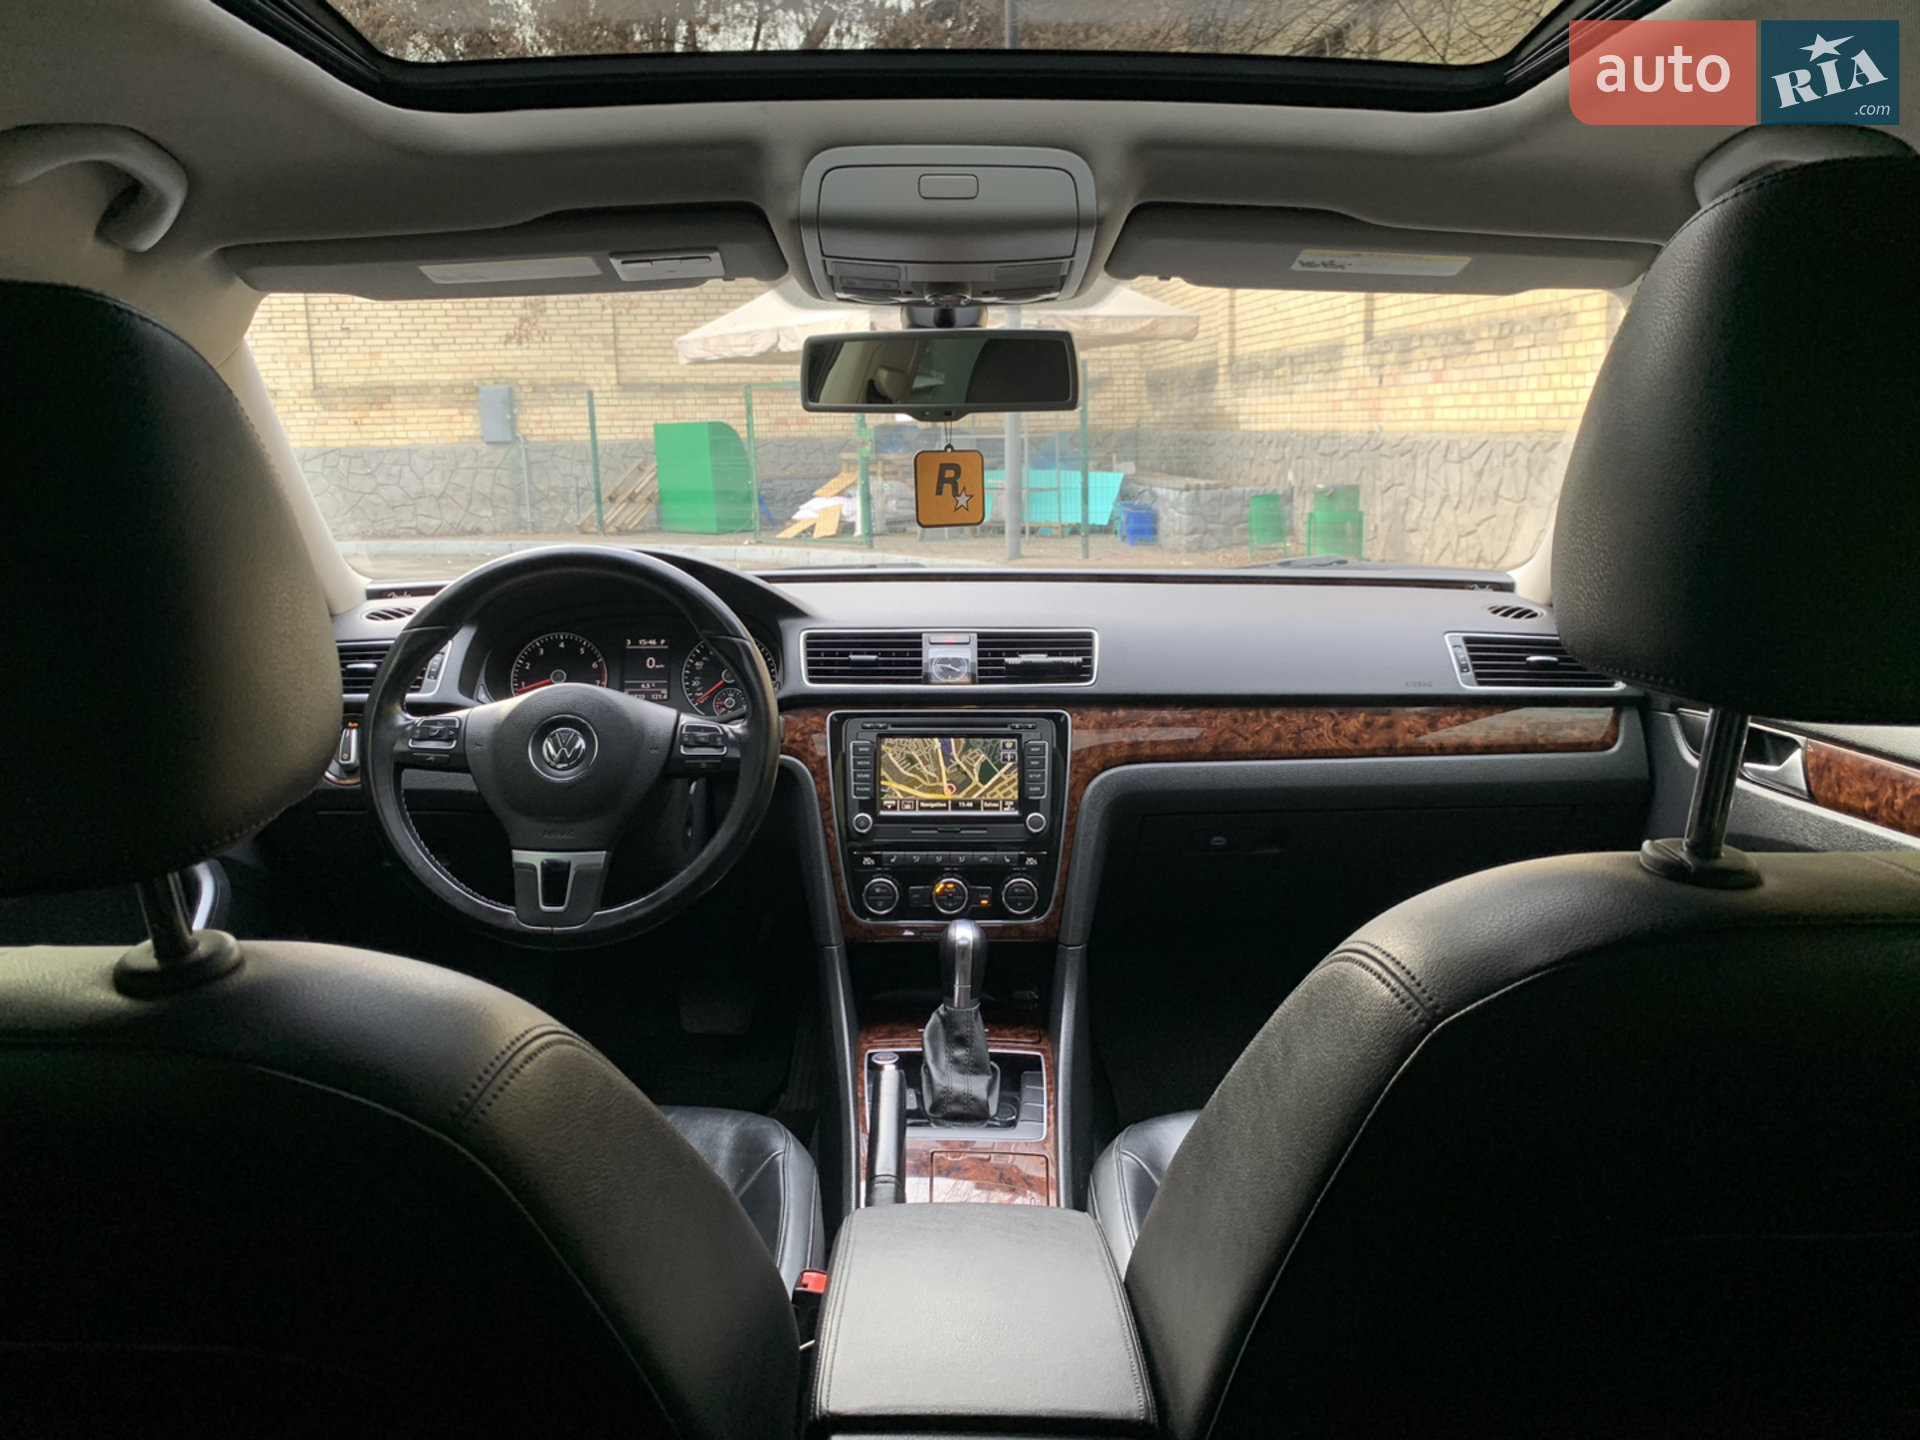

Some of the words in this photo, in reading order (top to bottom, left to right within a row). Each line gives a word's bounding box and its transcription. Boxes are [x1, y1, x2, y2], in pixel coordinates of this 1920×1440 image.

[935, 462, 962, 497] R
[538, 647, 544, 655] 3
[525, 662, 531, 670] 2
